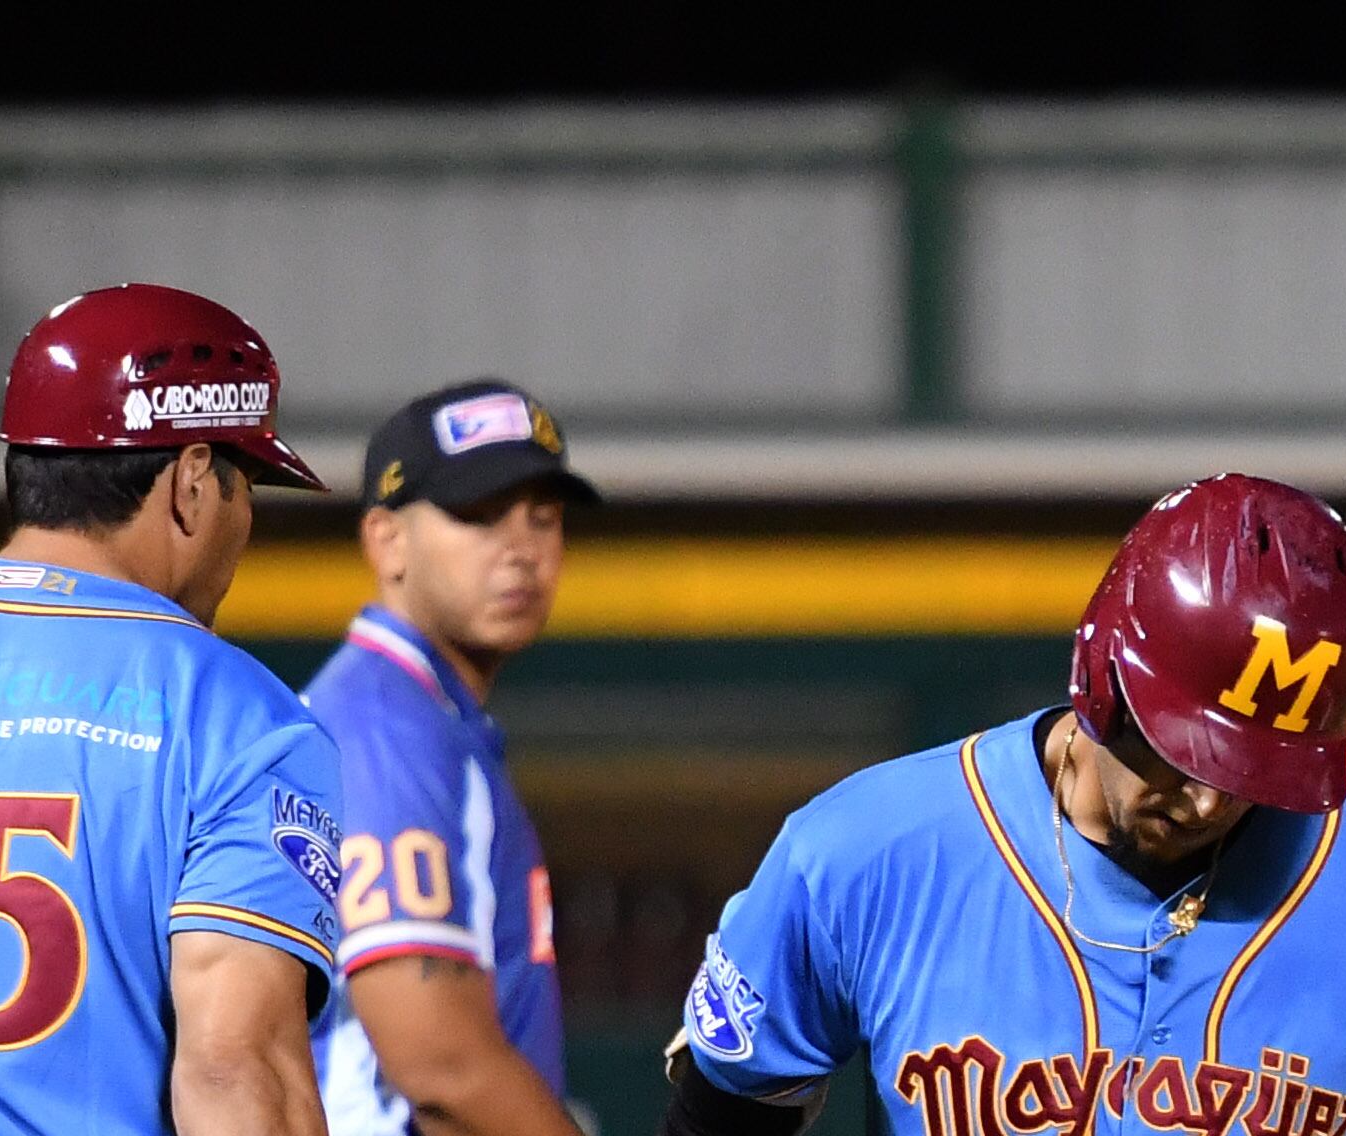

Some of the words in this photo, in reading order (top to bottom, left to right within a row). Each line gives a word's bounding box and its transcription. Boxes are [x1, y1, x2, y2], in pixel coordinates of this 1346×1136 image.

[152, 385, 195, 414] CABO
[201, 383, 239, 412] ROJO
[1218, 615, 1342, 733] M
[18, 714, 162, 752] PROTECTION
[340, 827, 453, 934] 20
